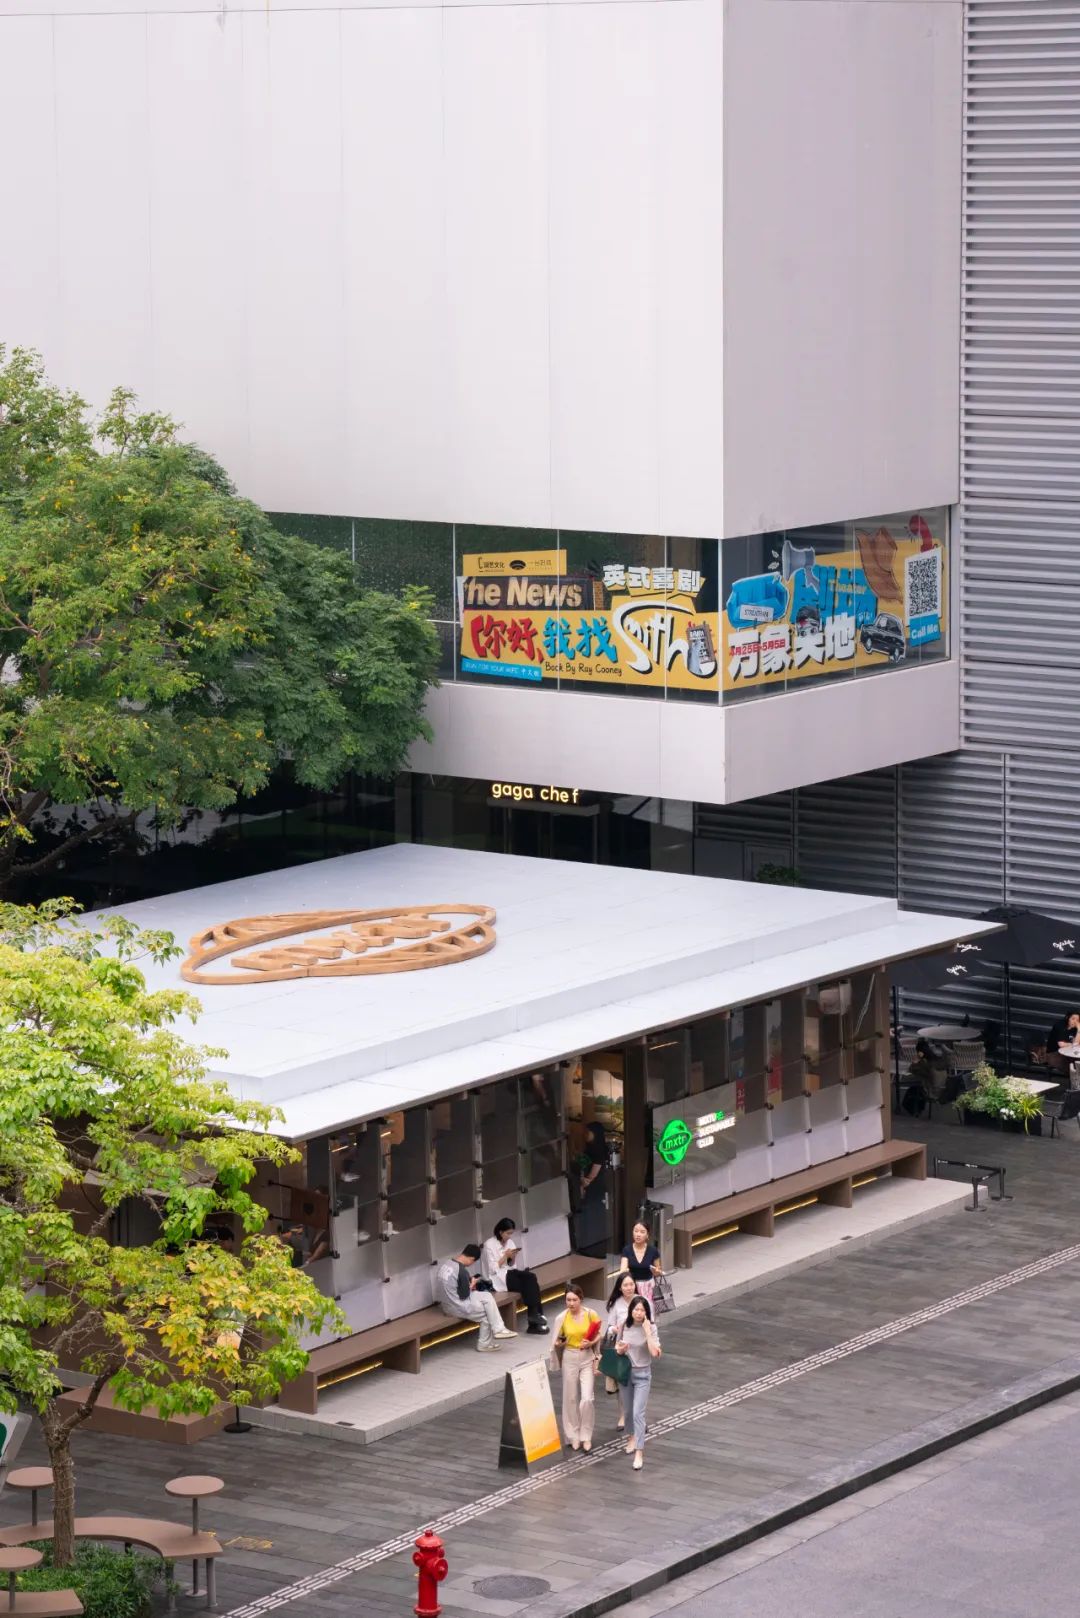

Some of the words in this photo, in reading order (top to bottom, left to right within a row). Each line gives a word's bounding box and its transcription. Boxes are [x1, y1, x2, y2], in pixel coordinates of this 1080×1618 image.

[506, 577, 582, 607] News
[613, 600, 717, 678] Smith
[565, 662, 576, 674] By
[578, 663, 593, 675] Ray
[595, 664, 622, 676] Cooney
[492, 783, 534, 801] gaga
[540, 785, 579, 804] chef
[665, 1133, 687, 1149] mxtr
